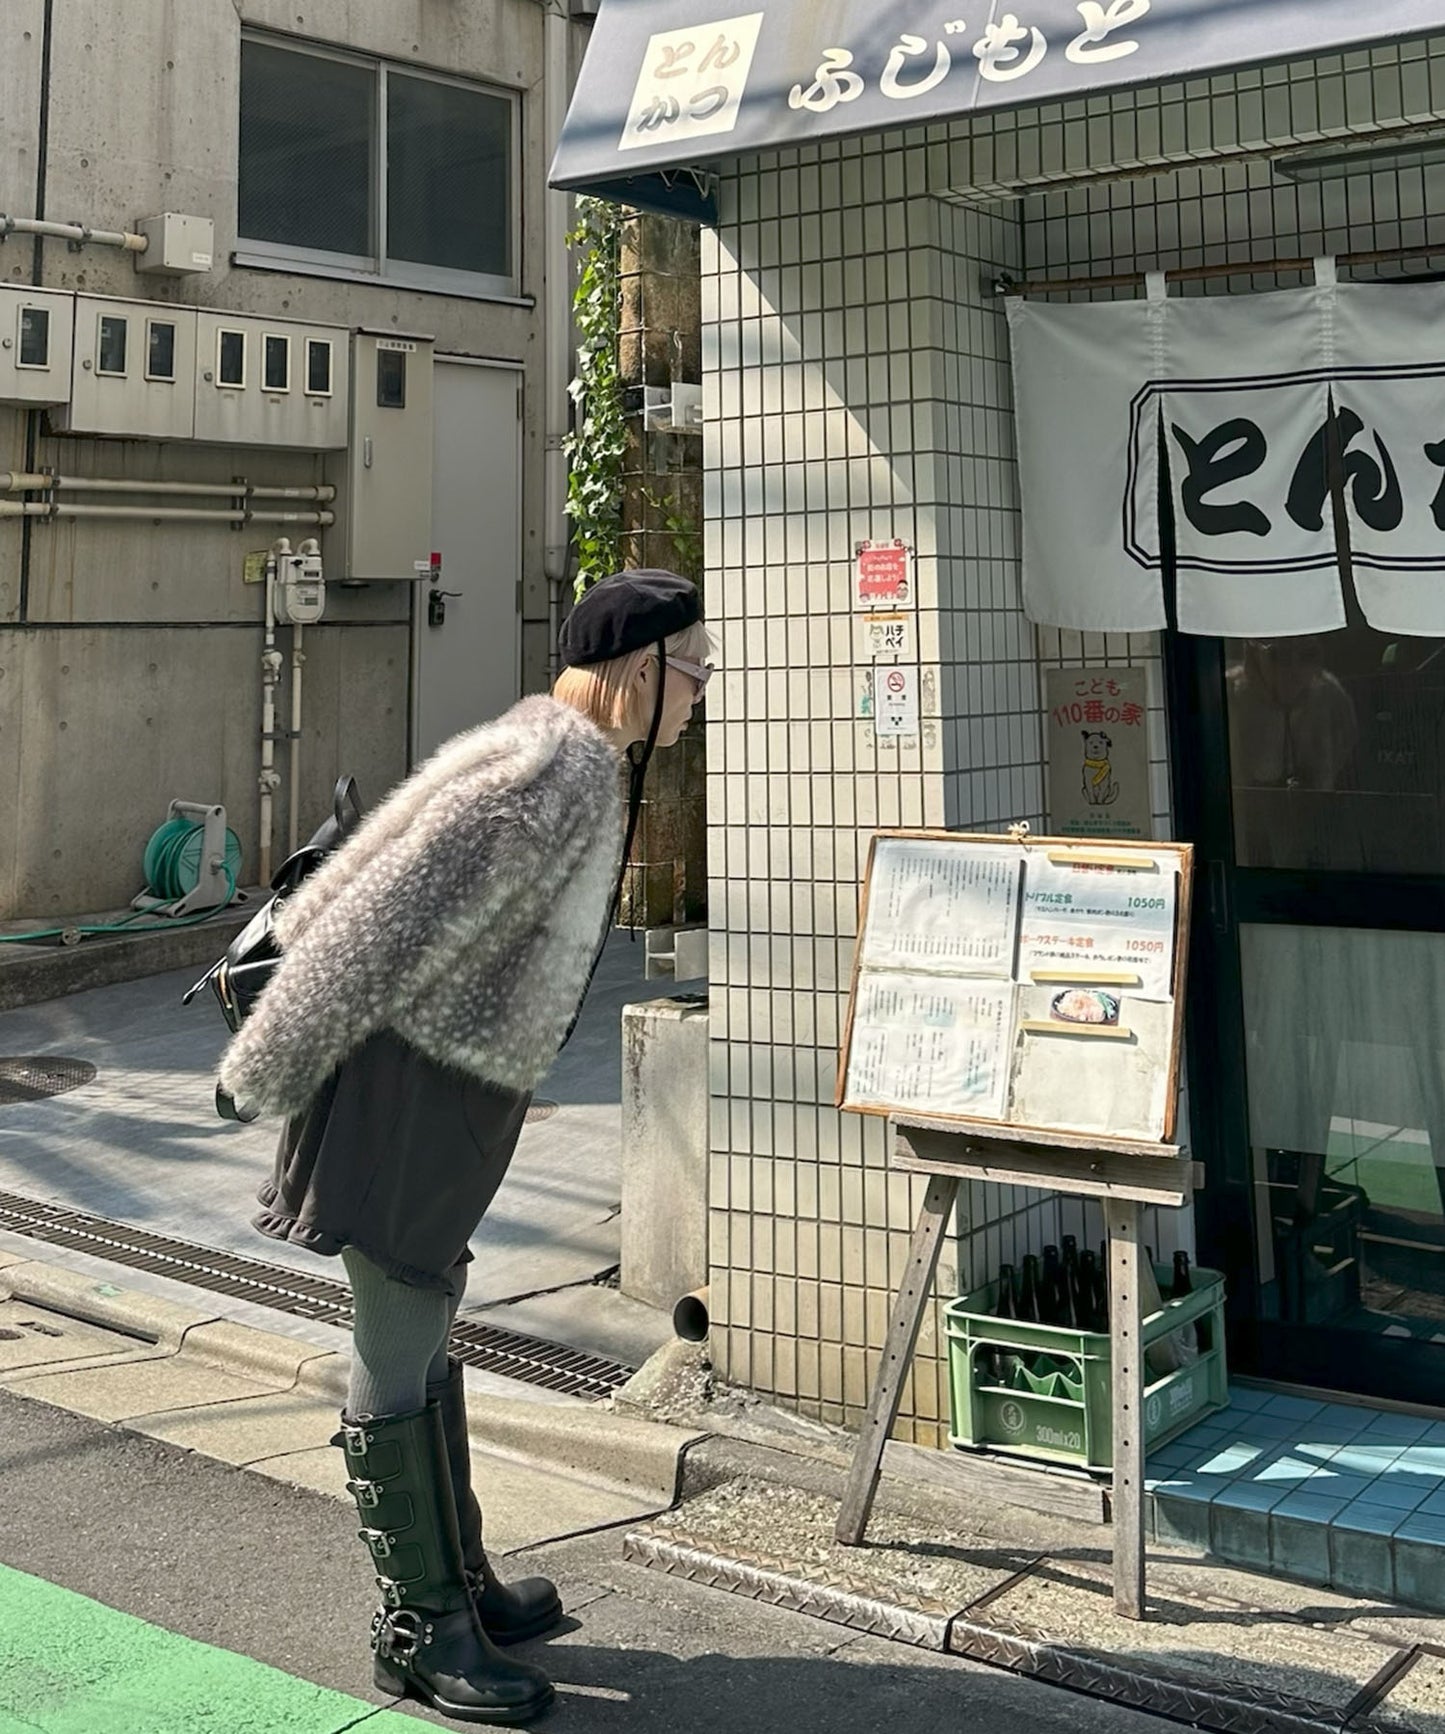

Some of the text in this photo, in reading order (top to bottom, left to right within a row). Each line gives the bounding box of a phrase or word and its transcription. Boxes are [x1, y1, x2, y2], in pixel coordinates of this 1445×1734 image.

[654, 33, 740, 80] とん
[788, 0, 1152, 112] ふじもと
[636, 84, 729, 131] かつ
[1171, 405, 1445, 537] とん
[885, 624, 904, 637] ハチ
[1074, 678, 1121, 697] こども
[1053, 699, 1144, 727] 110番の家
[1128, 896, 1166, 910] 1050円
[1125, 939, 1165, 953] 1050円
